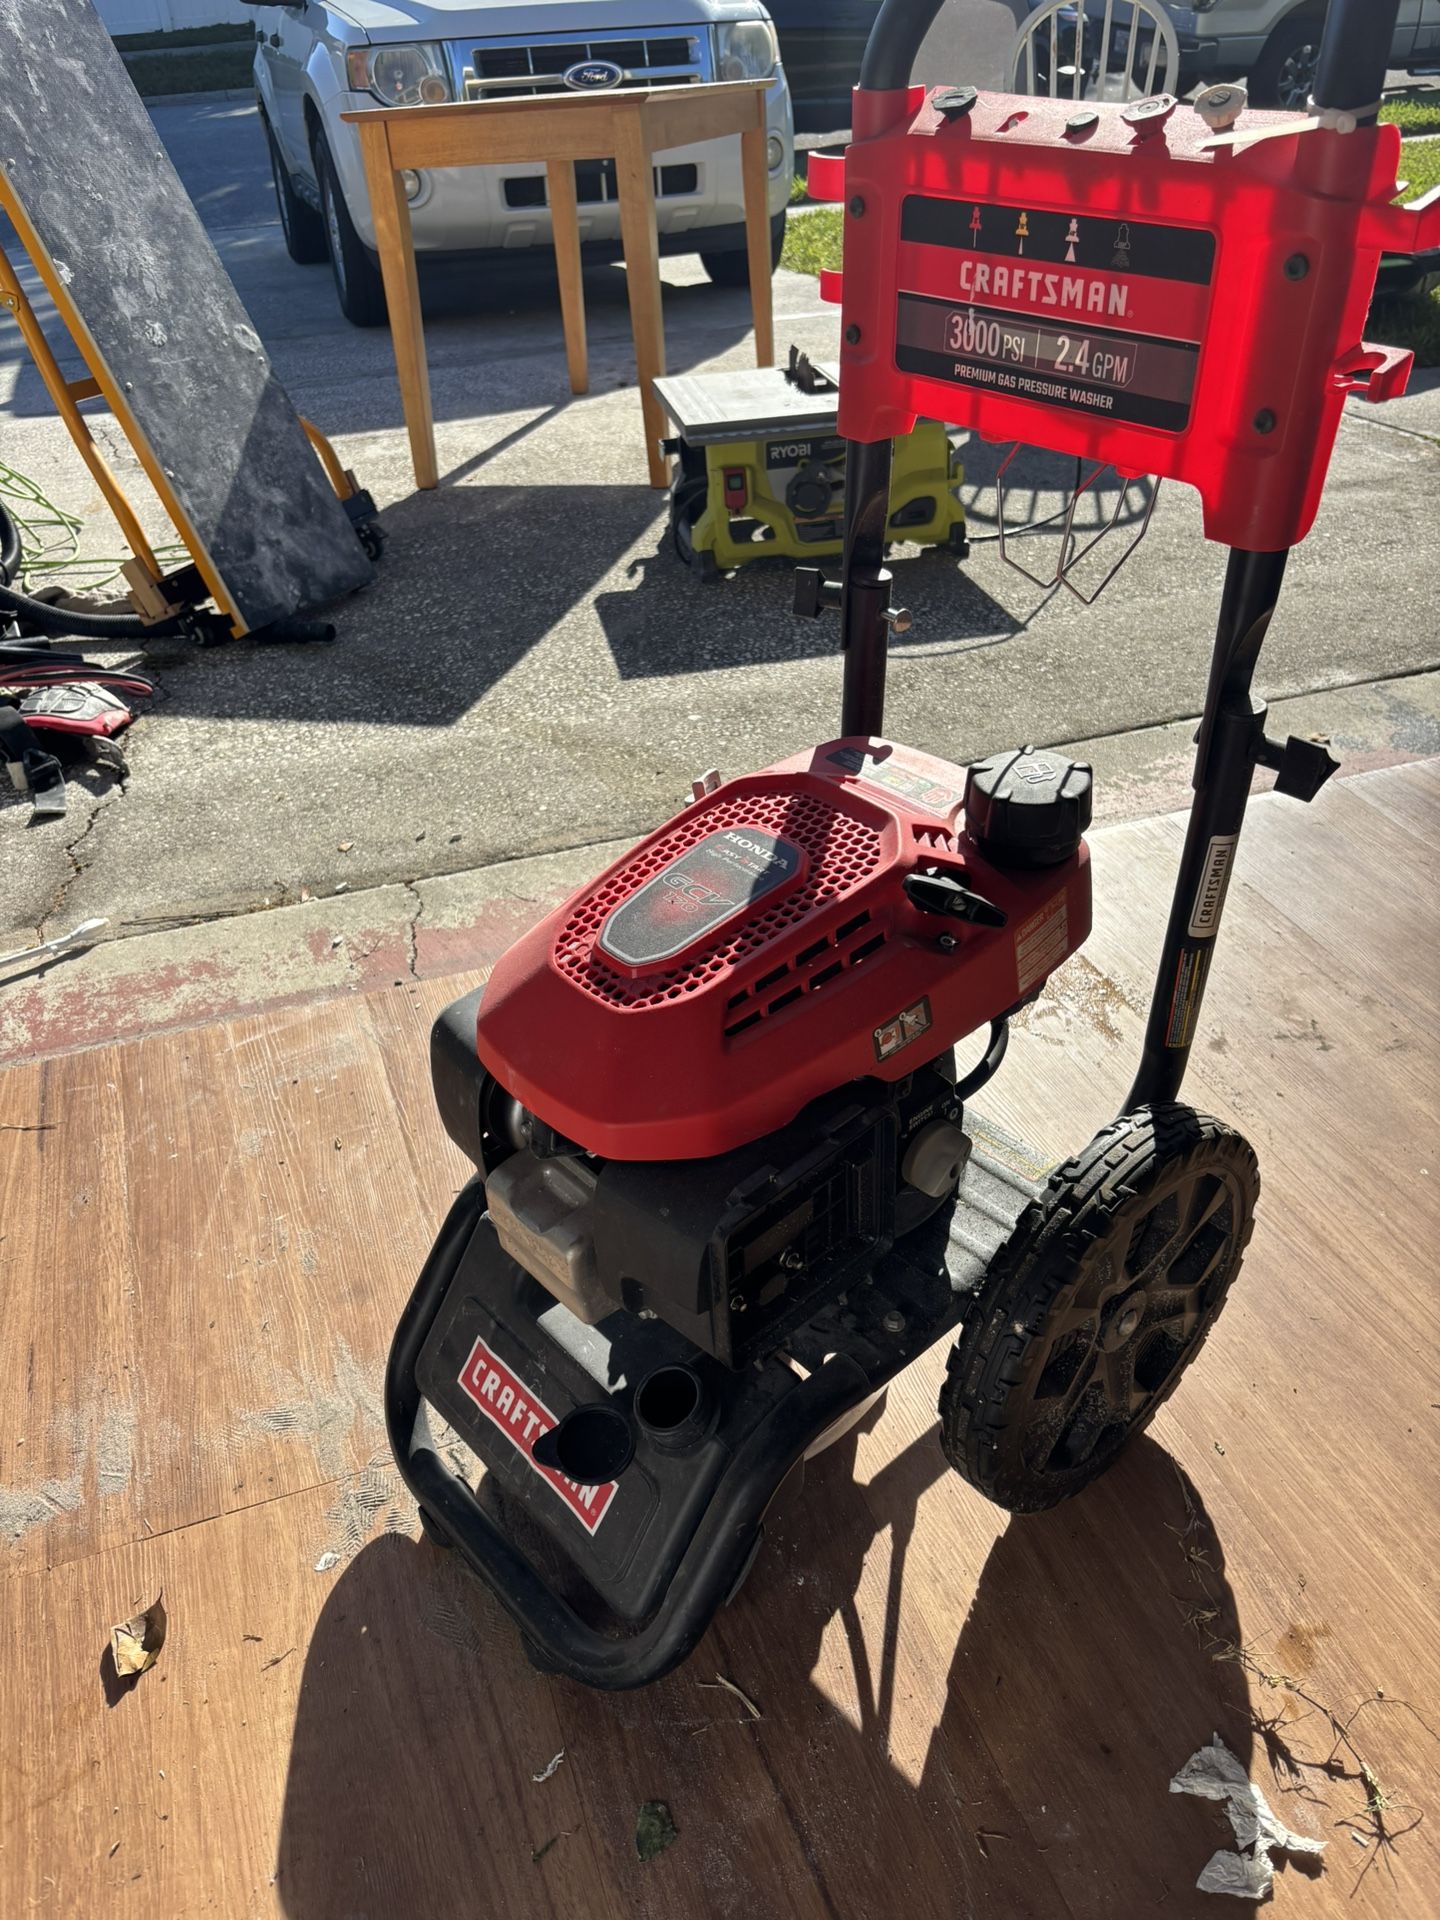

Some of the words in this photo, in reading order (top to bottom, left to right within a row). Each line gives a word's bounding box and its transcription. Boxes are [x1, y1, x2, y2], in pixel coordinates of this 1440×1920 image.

[581, 68, 608, 81] Ford
[960, 261, 1128, 316] CRAFTSMAN
[950, 315, 1000, 356] 3000
[1002, 334, 1025, 363] PSI
[1054, 335, 1090, 375] 2.4
[1092, 351, 1128, 384] GPM
[954, 363, 996, 384] PREMIUM
[997, 373, 1016, 389] GAS
[1018, 379, 1067, 400] PRESSURE
[1069, 388, 1113, 410] WASHER
[770, 443, 811, 460] RYOBI
[723, 831, 788, 870] HONDA
[662, 872, 735, 905] GCV
[662, 891, 699, 913] 170
[1199, 849, 1228, 923] CRAFTSMAN
[471, 1359, 600, 1511] CRAFTN
